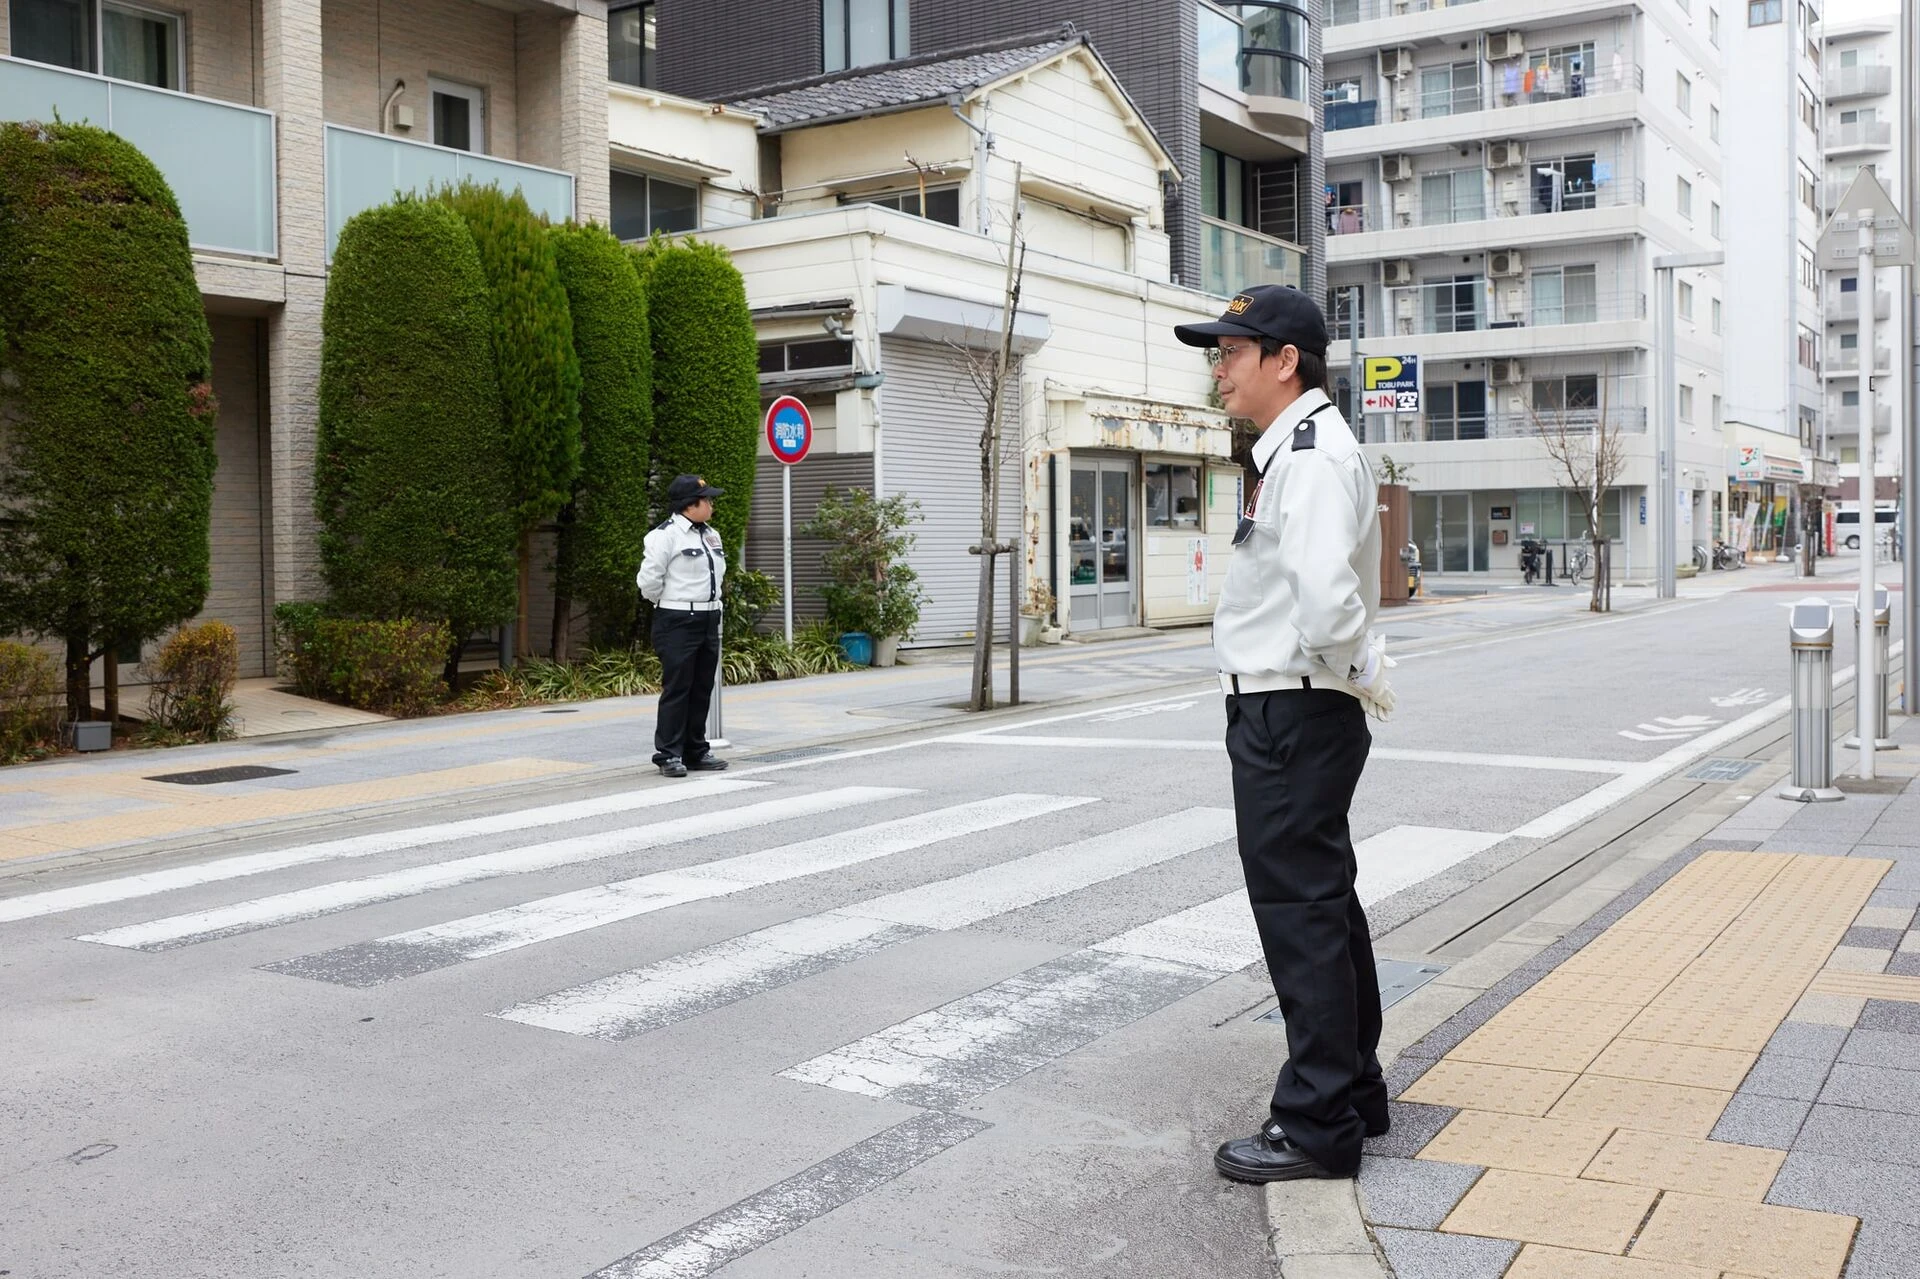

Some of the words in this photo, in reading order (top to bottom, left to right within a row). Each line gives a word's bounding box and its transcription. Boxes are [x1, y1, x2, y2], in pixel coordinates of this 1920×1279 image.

[1365, 357, 1402, 389] P
[1377, 381, 1396, 389] TOBU
[1379, 395, 1394, 408] IN
[1396, 391, 1418, 411] 空
[775, 422, 804, 439] 消防水利
